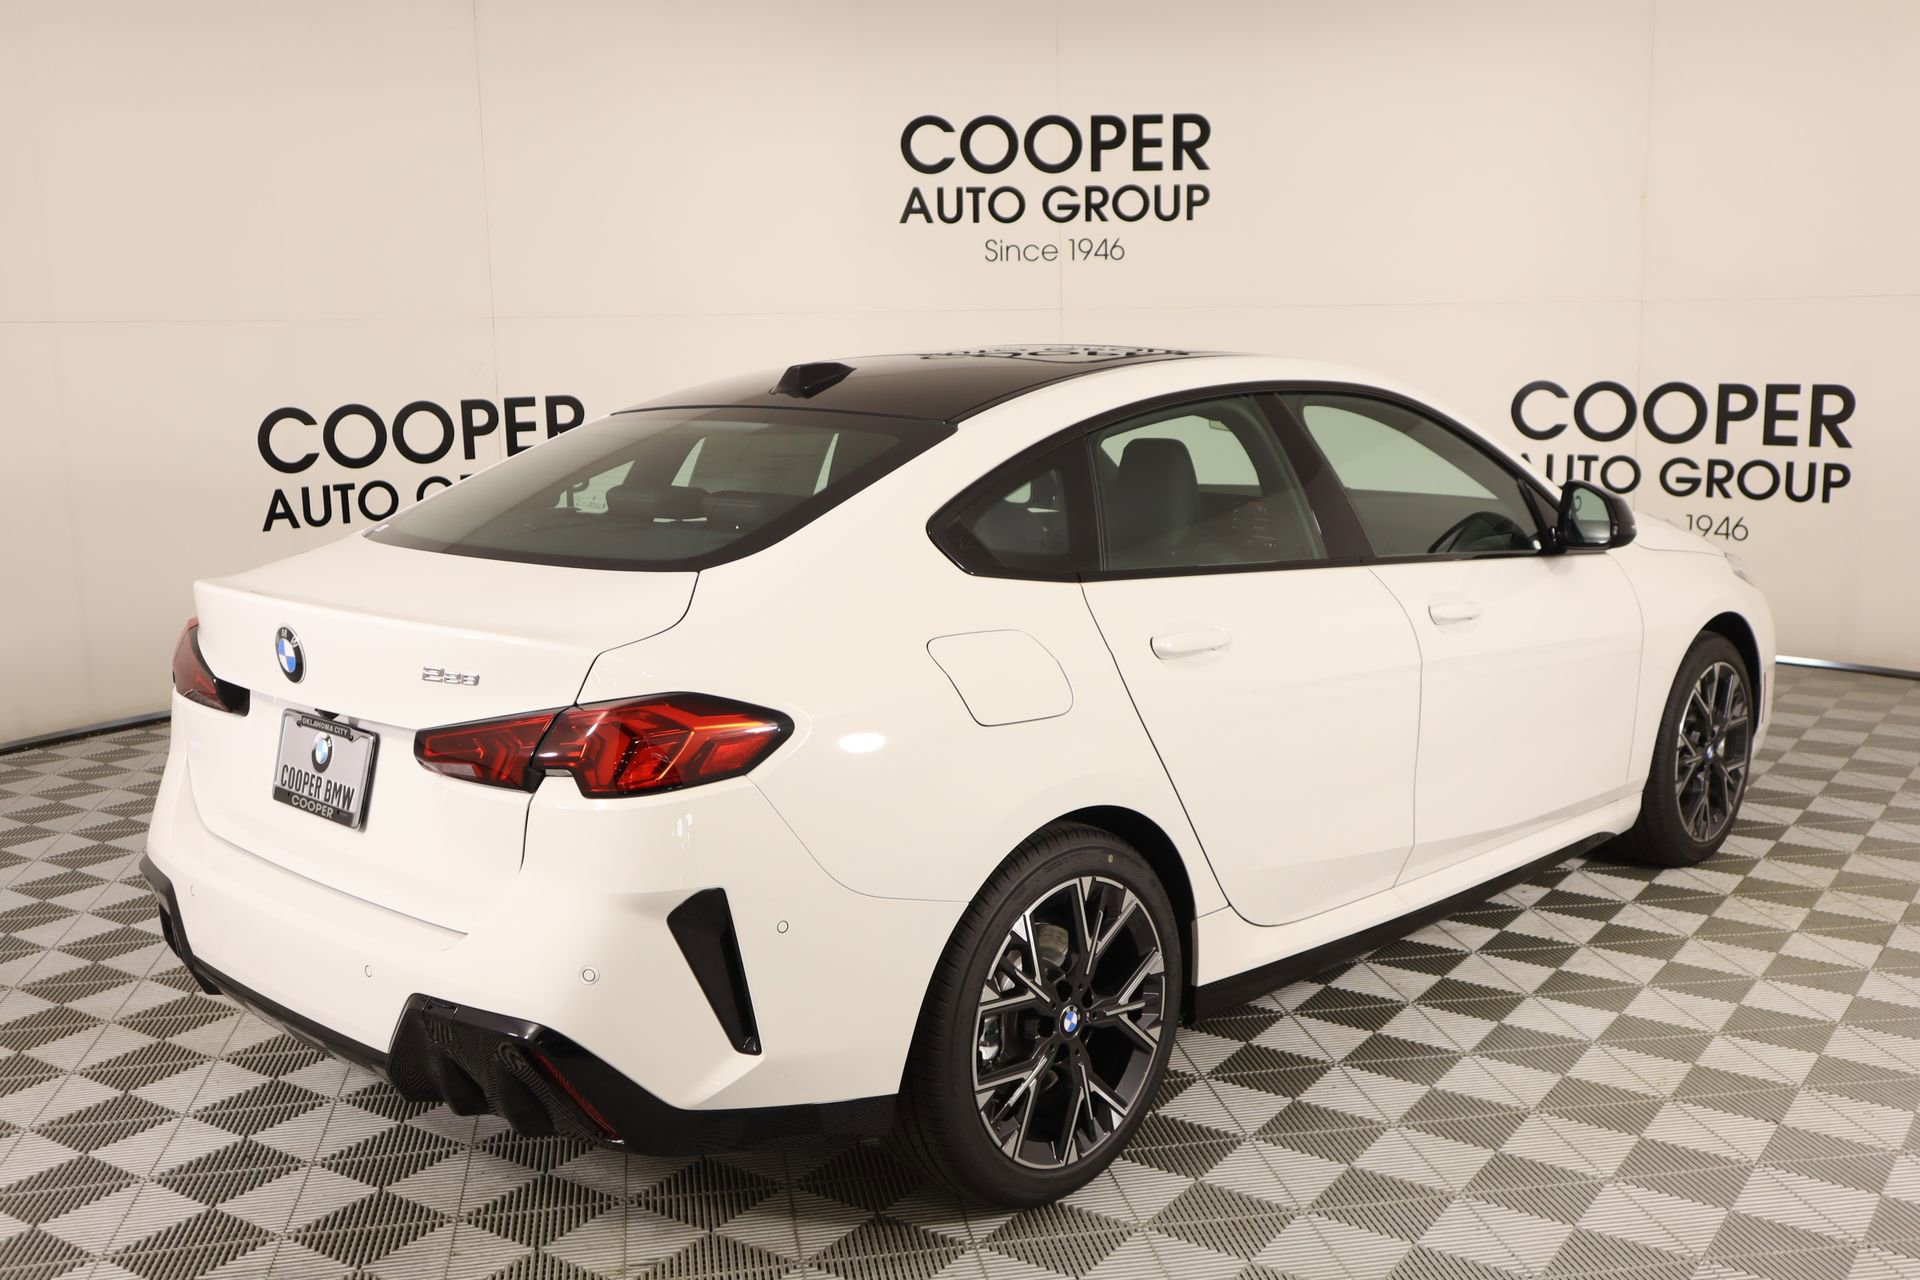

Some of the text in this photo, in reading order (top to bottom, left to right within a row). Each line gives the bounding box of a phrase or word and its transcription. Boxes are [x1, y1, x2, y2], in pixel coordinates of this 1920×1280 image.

[900, 113, 1211, 174] COOPER
[899, 184, 1210, 224] AUTO GROUP
[985, 238, 1125, 262] Since 1946
[1511, 380, 1856, 449] COOPER
[1521, 453, 1851, 503] UTO GROUP
[262, 480, 399, 532] AUTO
[1685, 513, 1749, 541] 1946
[302, 716, 349, 737] OKLAHOMA CITY
[280, 764, 355, 811] COOPER BMW
[291, 794, 334, 819] COOPER
